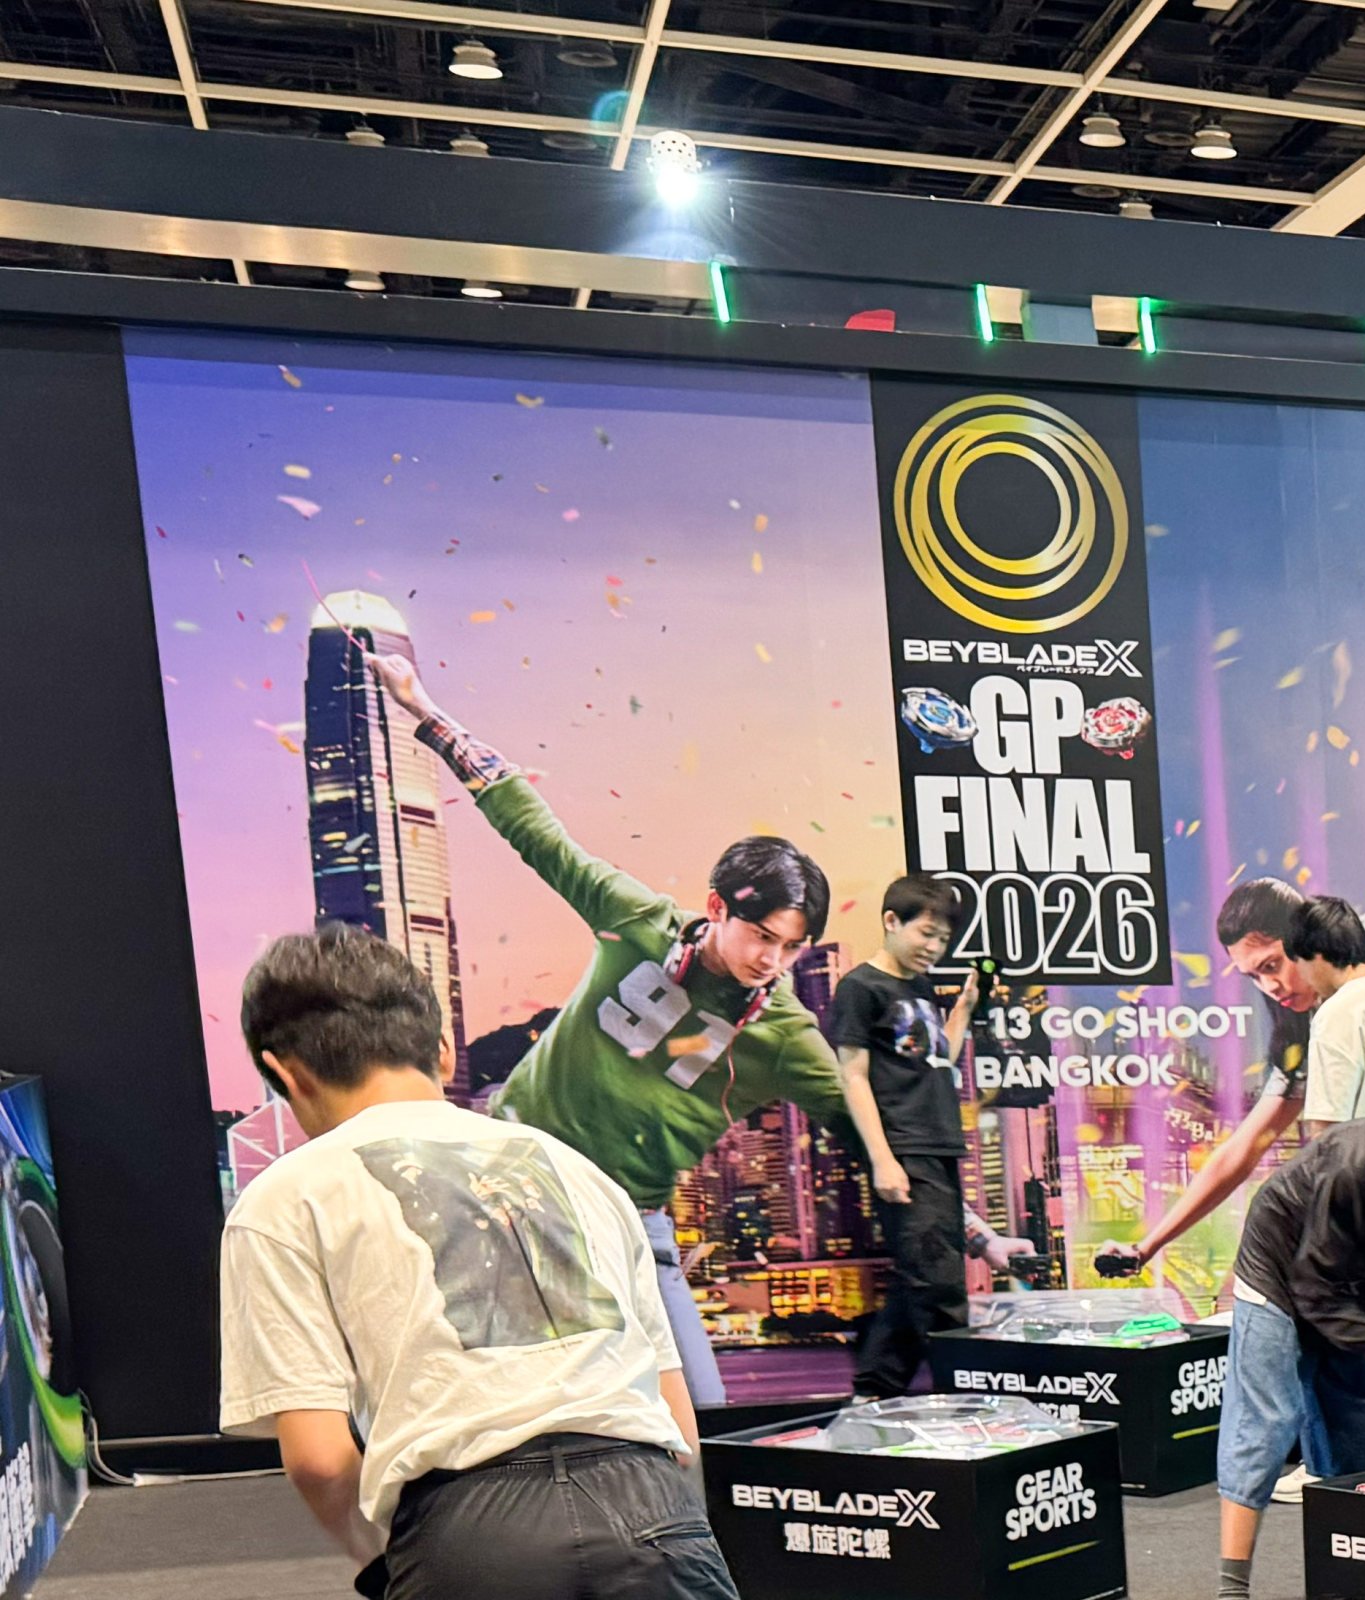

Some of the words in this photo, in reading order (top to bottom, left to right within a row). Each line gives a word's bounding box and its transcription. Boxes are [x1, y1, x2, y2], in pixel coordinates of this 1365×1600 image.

[969, 675, 1084, 775] GP
[914, 776, 1150, 873] FINAL
[928, 872, 1158, 976] 2026
[1041, 1006, 1102, 1040] GO
[1116, 1006, 1253, 1040] SHOOT
[975, 1053, 1175, 1089] BANGKOK
[1015, 1462, 1083, 1505] GEAR
[1005, 1488, 1097, 1541] SPORTS
[784, 1523, 892, 1559] 爆旋陀螺
